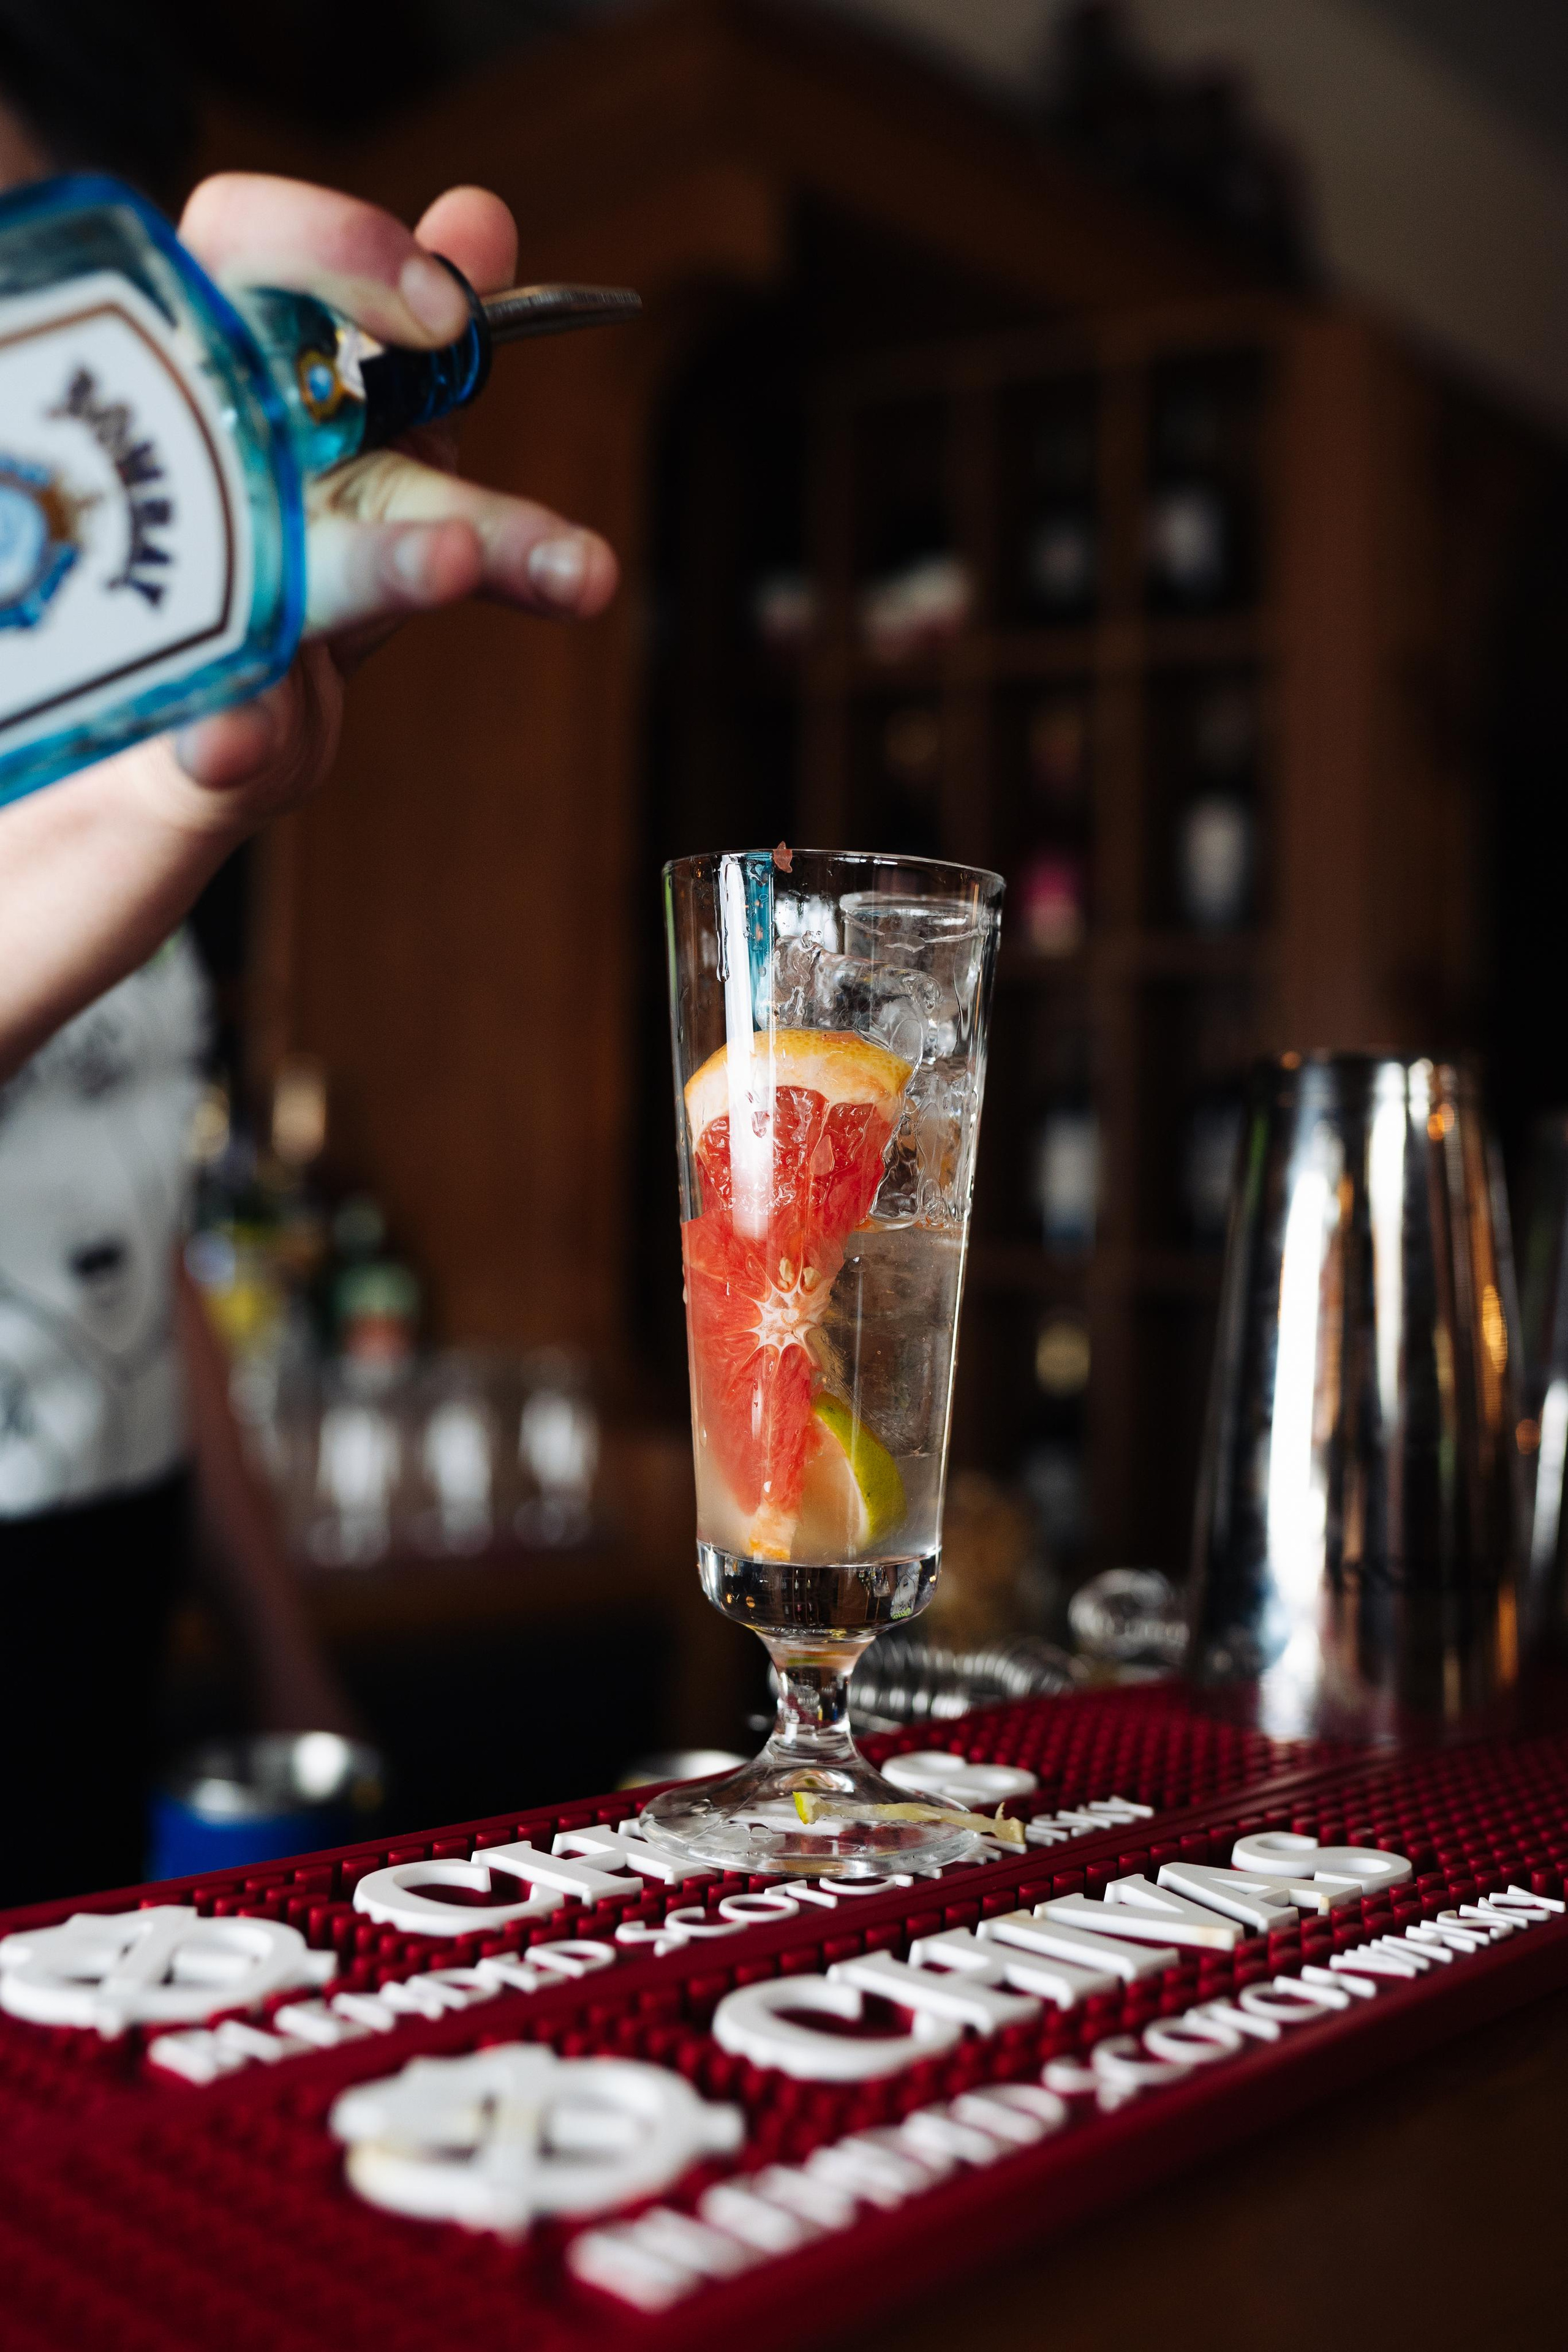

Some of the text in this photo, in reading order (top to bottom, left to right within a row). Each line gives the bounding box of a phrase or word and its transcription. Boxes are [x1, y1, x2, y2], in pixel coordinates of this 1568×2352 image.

[711, 1830, 1412, 2082] CHIVAS
[1041, 1964, 1378, 2113] SCOTCH
[1328, 1884, 1567, 1978] WHISKY
